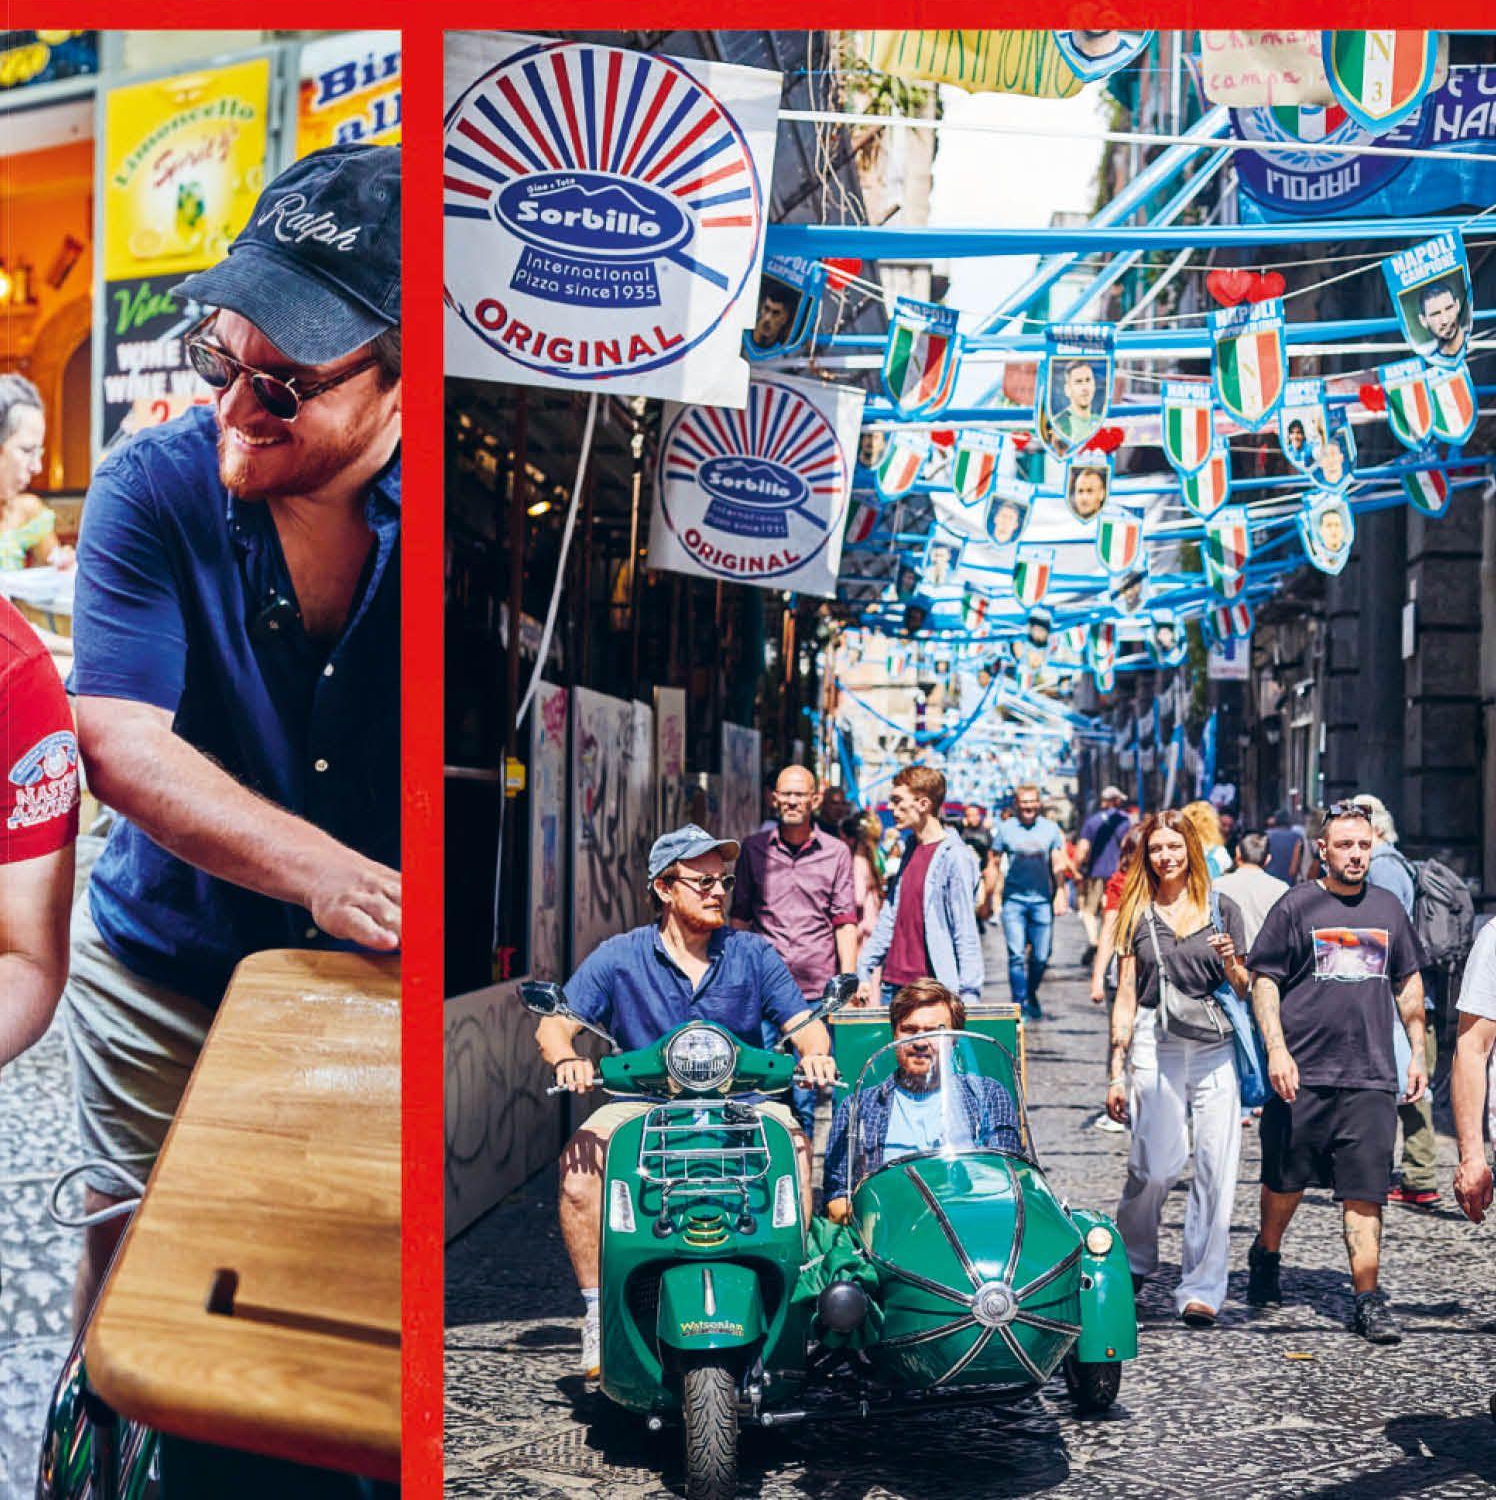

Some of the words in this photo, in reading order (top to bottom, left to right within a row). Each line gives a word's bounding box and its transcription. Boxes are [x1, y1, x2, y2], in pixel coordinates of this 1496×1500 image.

[1266, 162, 1362, 201] NAPOLI
[256, 192, 362, 252] Ralph
[516, 200, 661, 238] Sorbillo
[525, 251, 650, 281] International
[1390, 232, 1457, 275] NAPOLI
[515, 269, 559, 293] Pizza
[474, 298, 685, 367] ORIGINAL
[709, 471, 791, 498] Sorbillo
[684, 528, 801, 573] ORIGINAL
